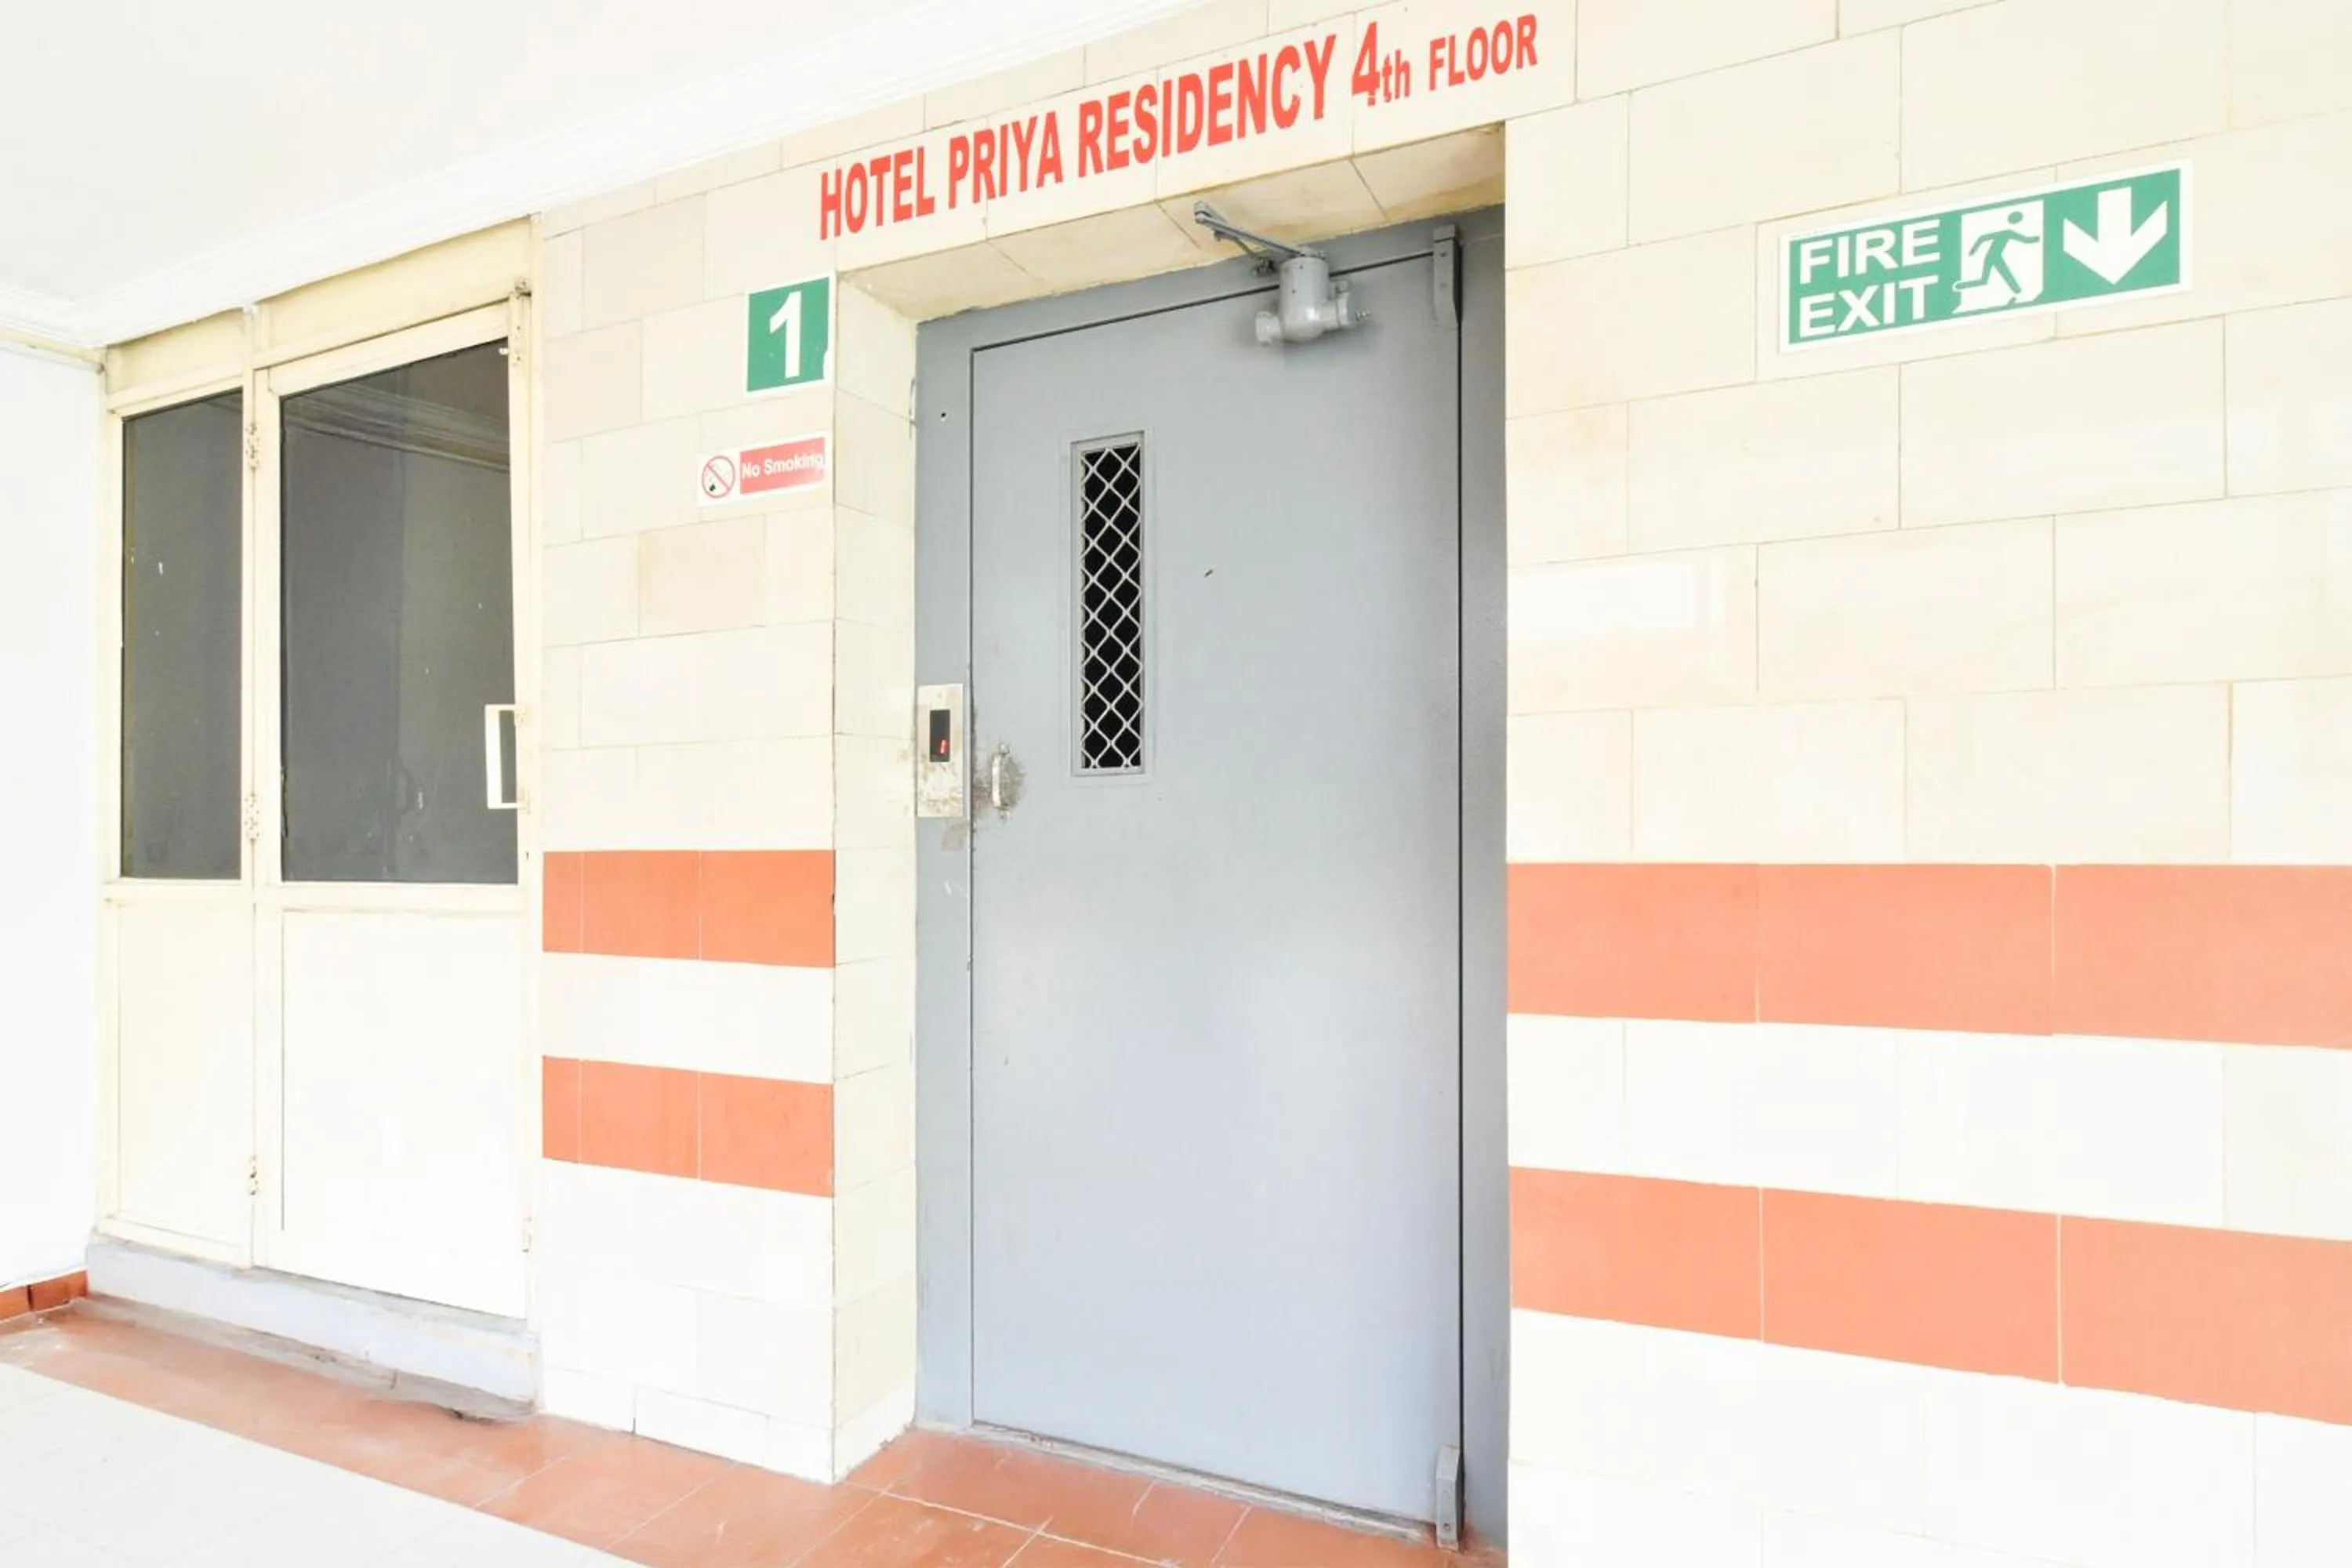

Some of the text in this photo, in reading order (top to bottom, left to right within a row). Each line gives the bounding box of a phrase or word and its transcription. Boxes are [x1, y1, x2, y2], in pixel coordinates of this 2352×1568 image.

[820, 13, 1537, 240] HOTEL PRIYA RESIDENCY 4th FLOOR
[1799, 219, 1941, 285] FIRE
[769, 290, 802, 379] 1
[1799, 274, 1939, 339] EXIT
[742, 452, 826, 481] No Smoking
